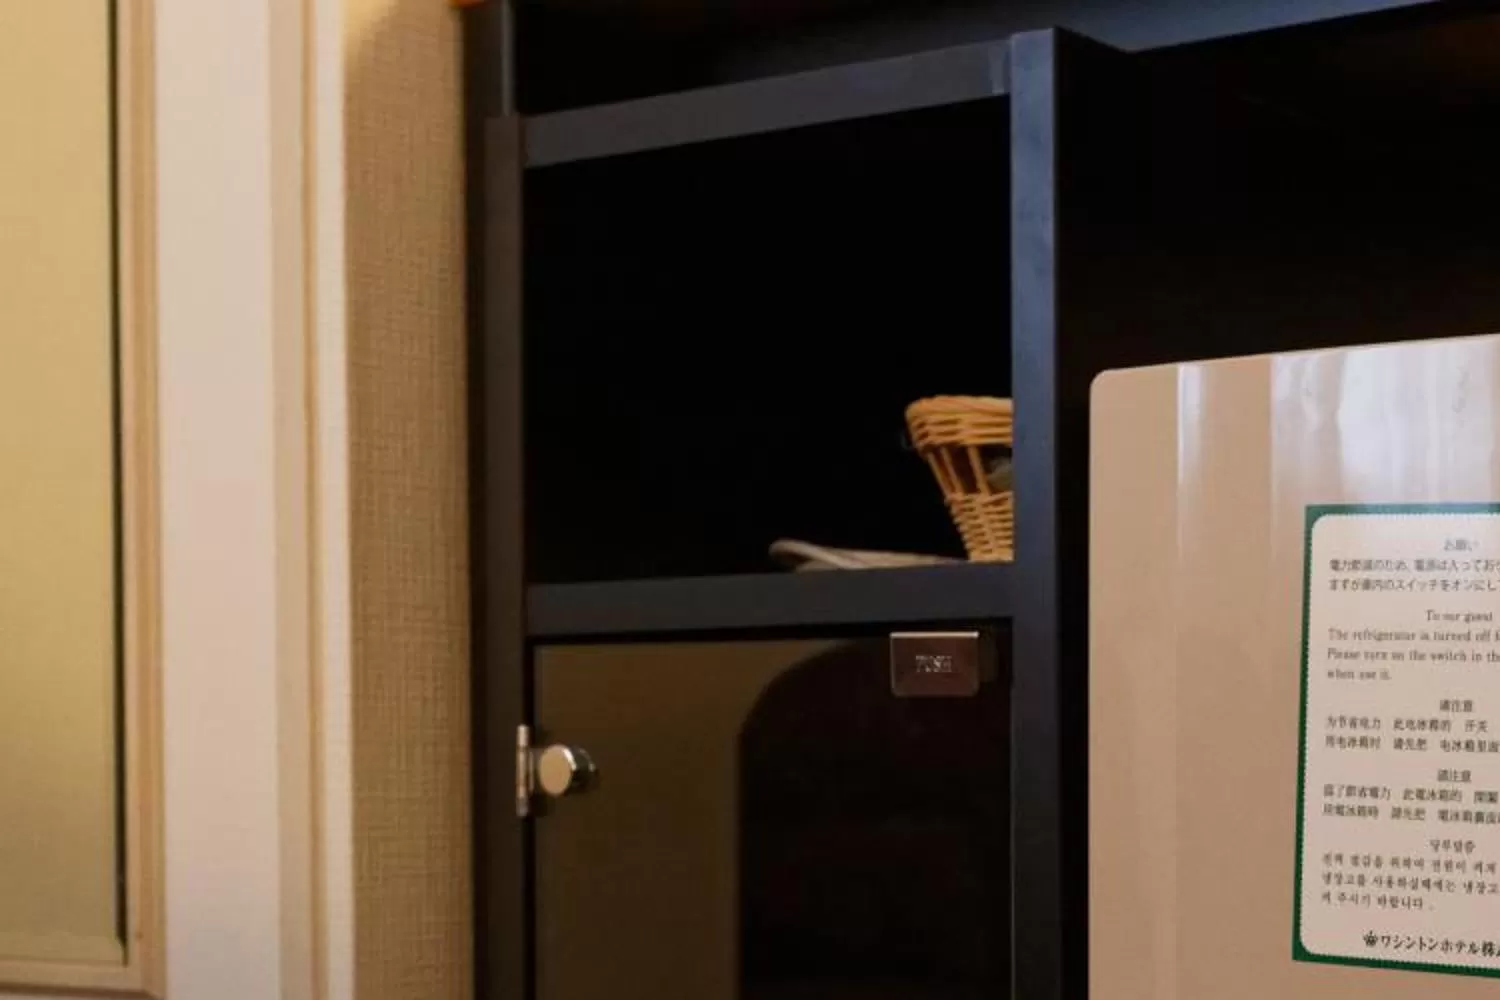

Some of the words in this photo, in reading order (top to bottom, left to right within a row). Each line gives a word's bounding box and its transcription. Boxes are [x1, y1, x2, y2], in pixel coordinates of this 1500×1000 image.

[1426, 609, 1440, 621] To
[1328, 628, 1348, 640] The
[1353, 628, 1416, 642] refrigerator
[1420, 630, 1430, 641] is
[1433, 629, 1471, 642] turned
[1476, 630, 1490, 642] off
[1327, 647, 1360, 660] Please
[1364, 650, 1388, 661] turn
[1391, 651, 1404, 661] on
[1409, 649, 1426, 661] the
[1430, 649, 1467, 662] switch
[1471, 649, 1482, 662] in
[1327, 668, 1355, 680] when
